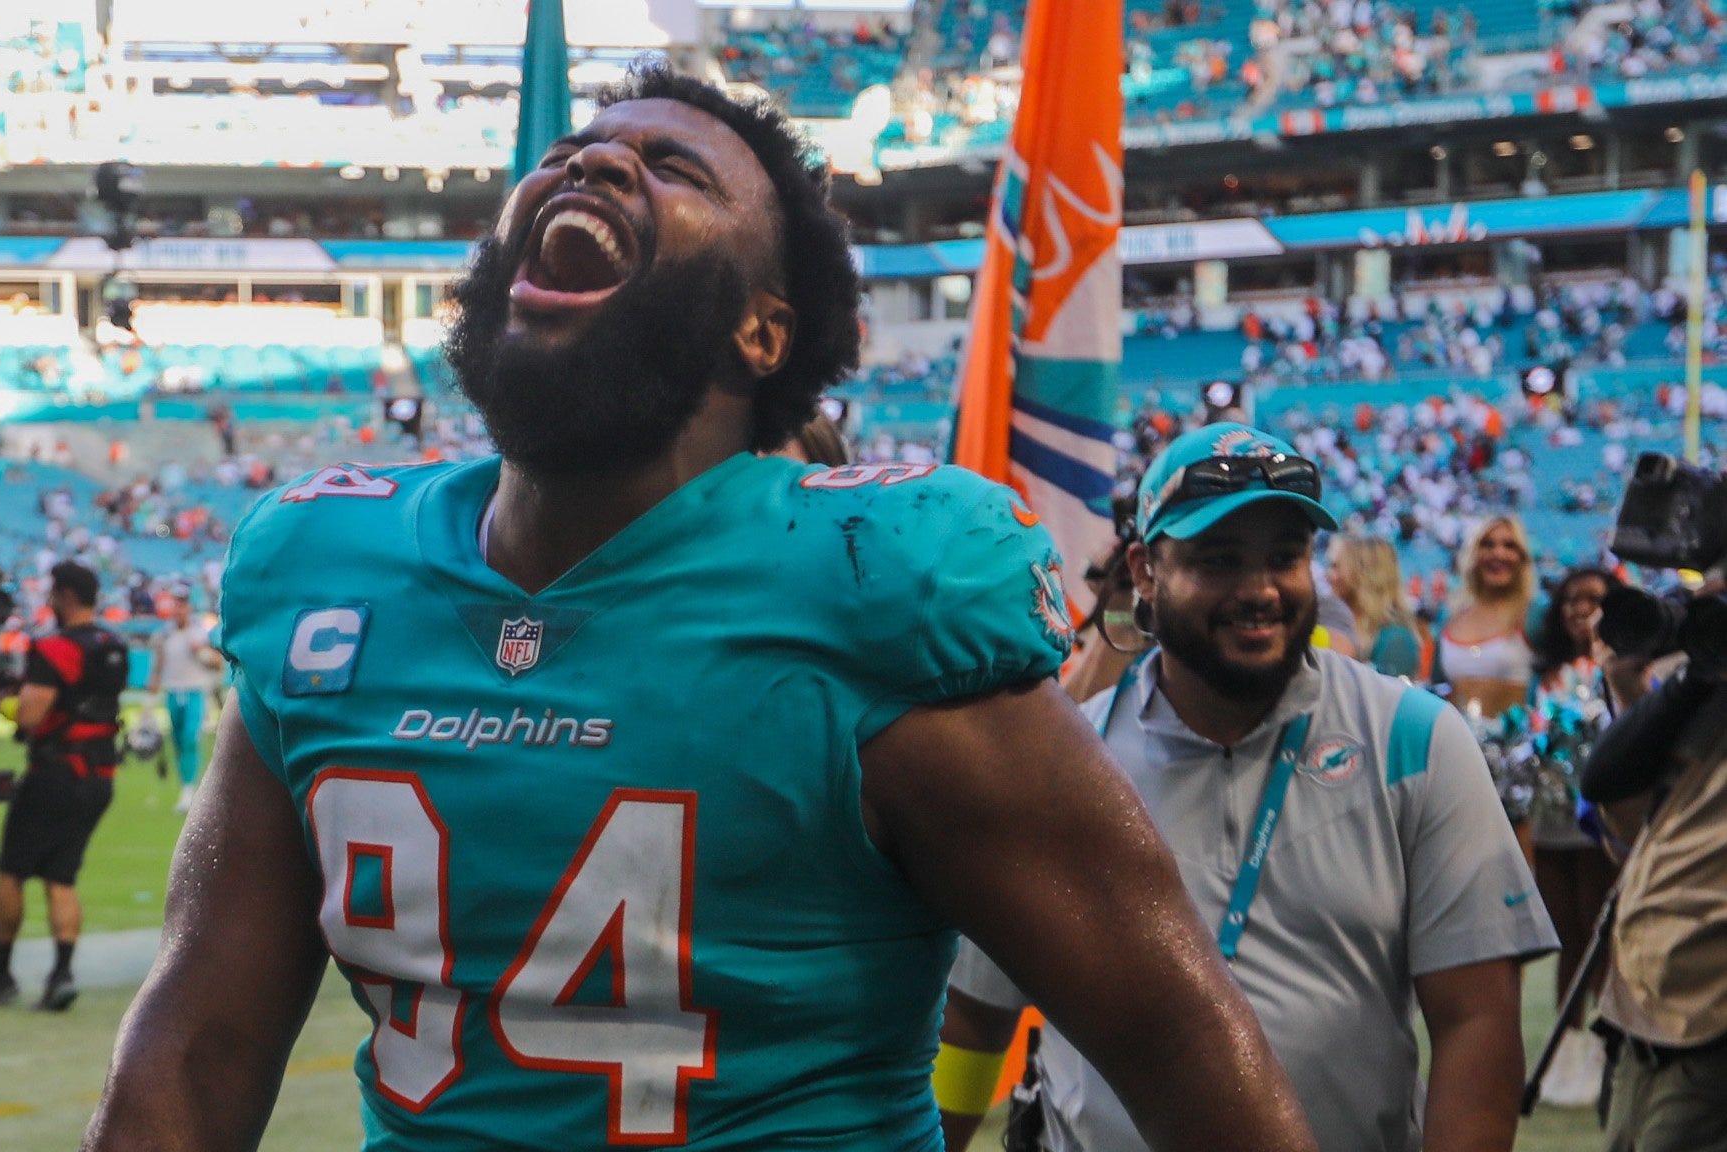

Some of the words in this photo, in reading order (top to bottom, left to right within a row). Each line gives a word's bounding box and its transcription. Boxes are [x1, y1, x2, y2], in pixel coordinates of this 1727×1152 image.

[289, 612, 363, 672] C
[503, 641, 532, 665] NFL
[391, 707, 613, 752] Dolphins
[306, 766, 721, 1146] 94
